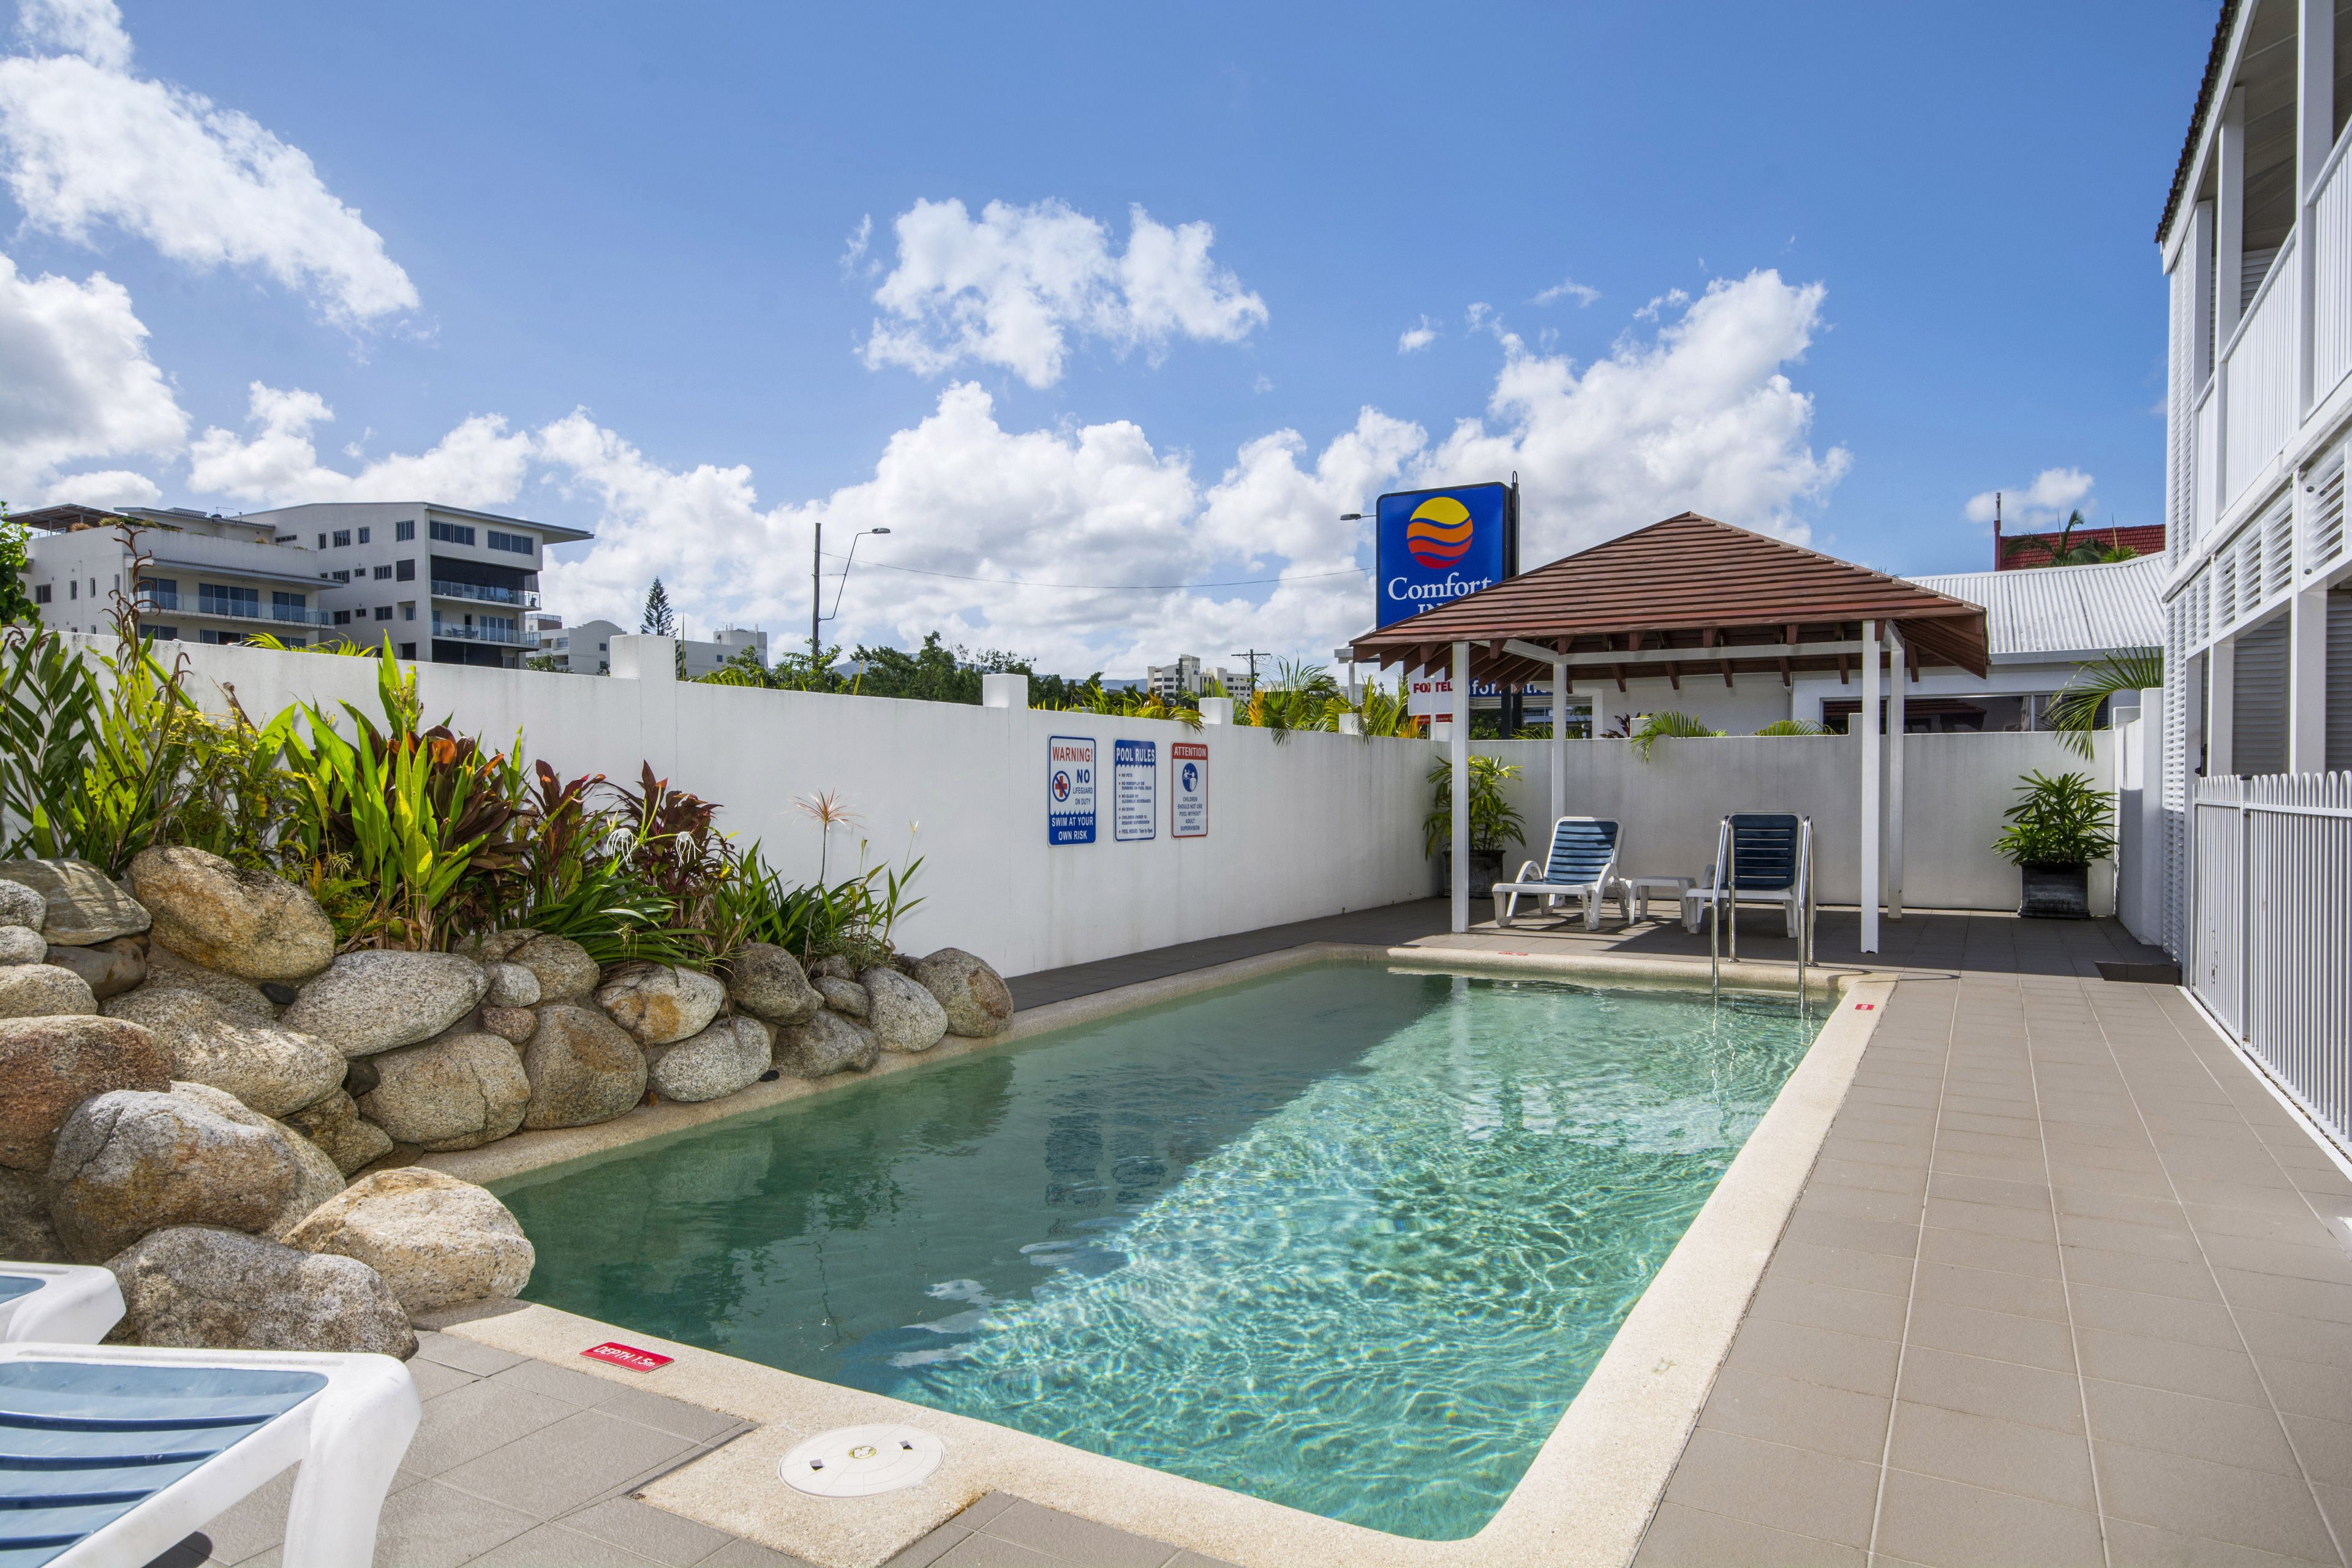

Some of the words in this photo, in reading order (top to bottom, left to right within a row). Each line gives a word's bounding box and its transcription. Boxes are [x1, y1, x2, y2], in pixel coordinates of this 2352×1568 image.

[1388, 571, 1492, 600] Comfort
[1052, 747, 1093, 763] WARNING!
[1116, 747, 1133, 762] POOL
[1135, 748, 1155, 763] RULES
[1174, 746, 1206, 757] ATTENTION
[1077, 769, 1090, 783] NO
[1052, 817, 1068, 827] SWIM
[1069, 816, 1076, 826] AT
[1077, 816, 1093, 826] YOUR
[1058, 831, 1072, 841] OWN
[1074, 830, 1087, 840] RISK
[593, 1346, 635, 1360] DEPTH
[631, 1356, 655, 1367] 1.5m
